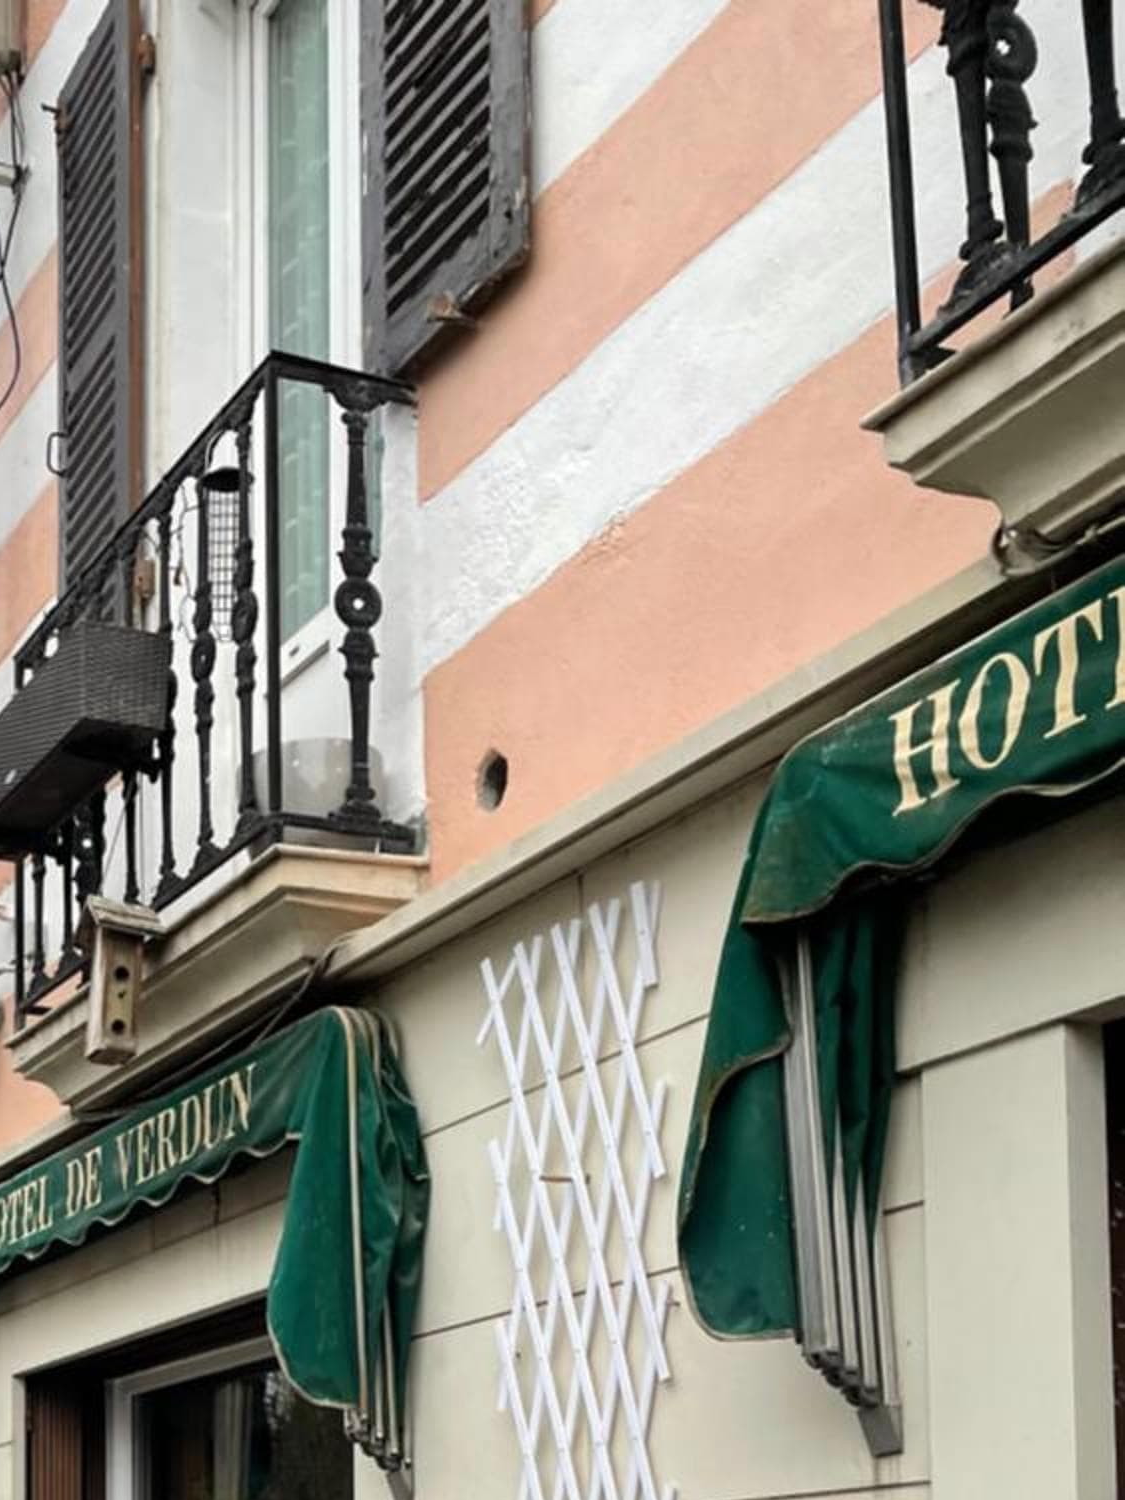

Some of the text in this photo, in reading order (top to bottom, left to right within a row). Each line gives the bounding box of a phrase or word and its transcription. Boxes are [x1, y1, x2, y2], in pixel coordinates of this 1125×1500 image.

[887, 585, 1125, 818] HOT
[64, 1145, 105, 1219] DE
[114, 1062, 258, 1192] VERDUN
